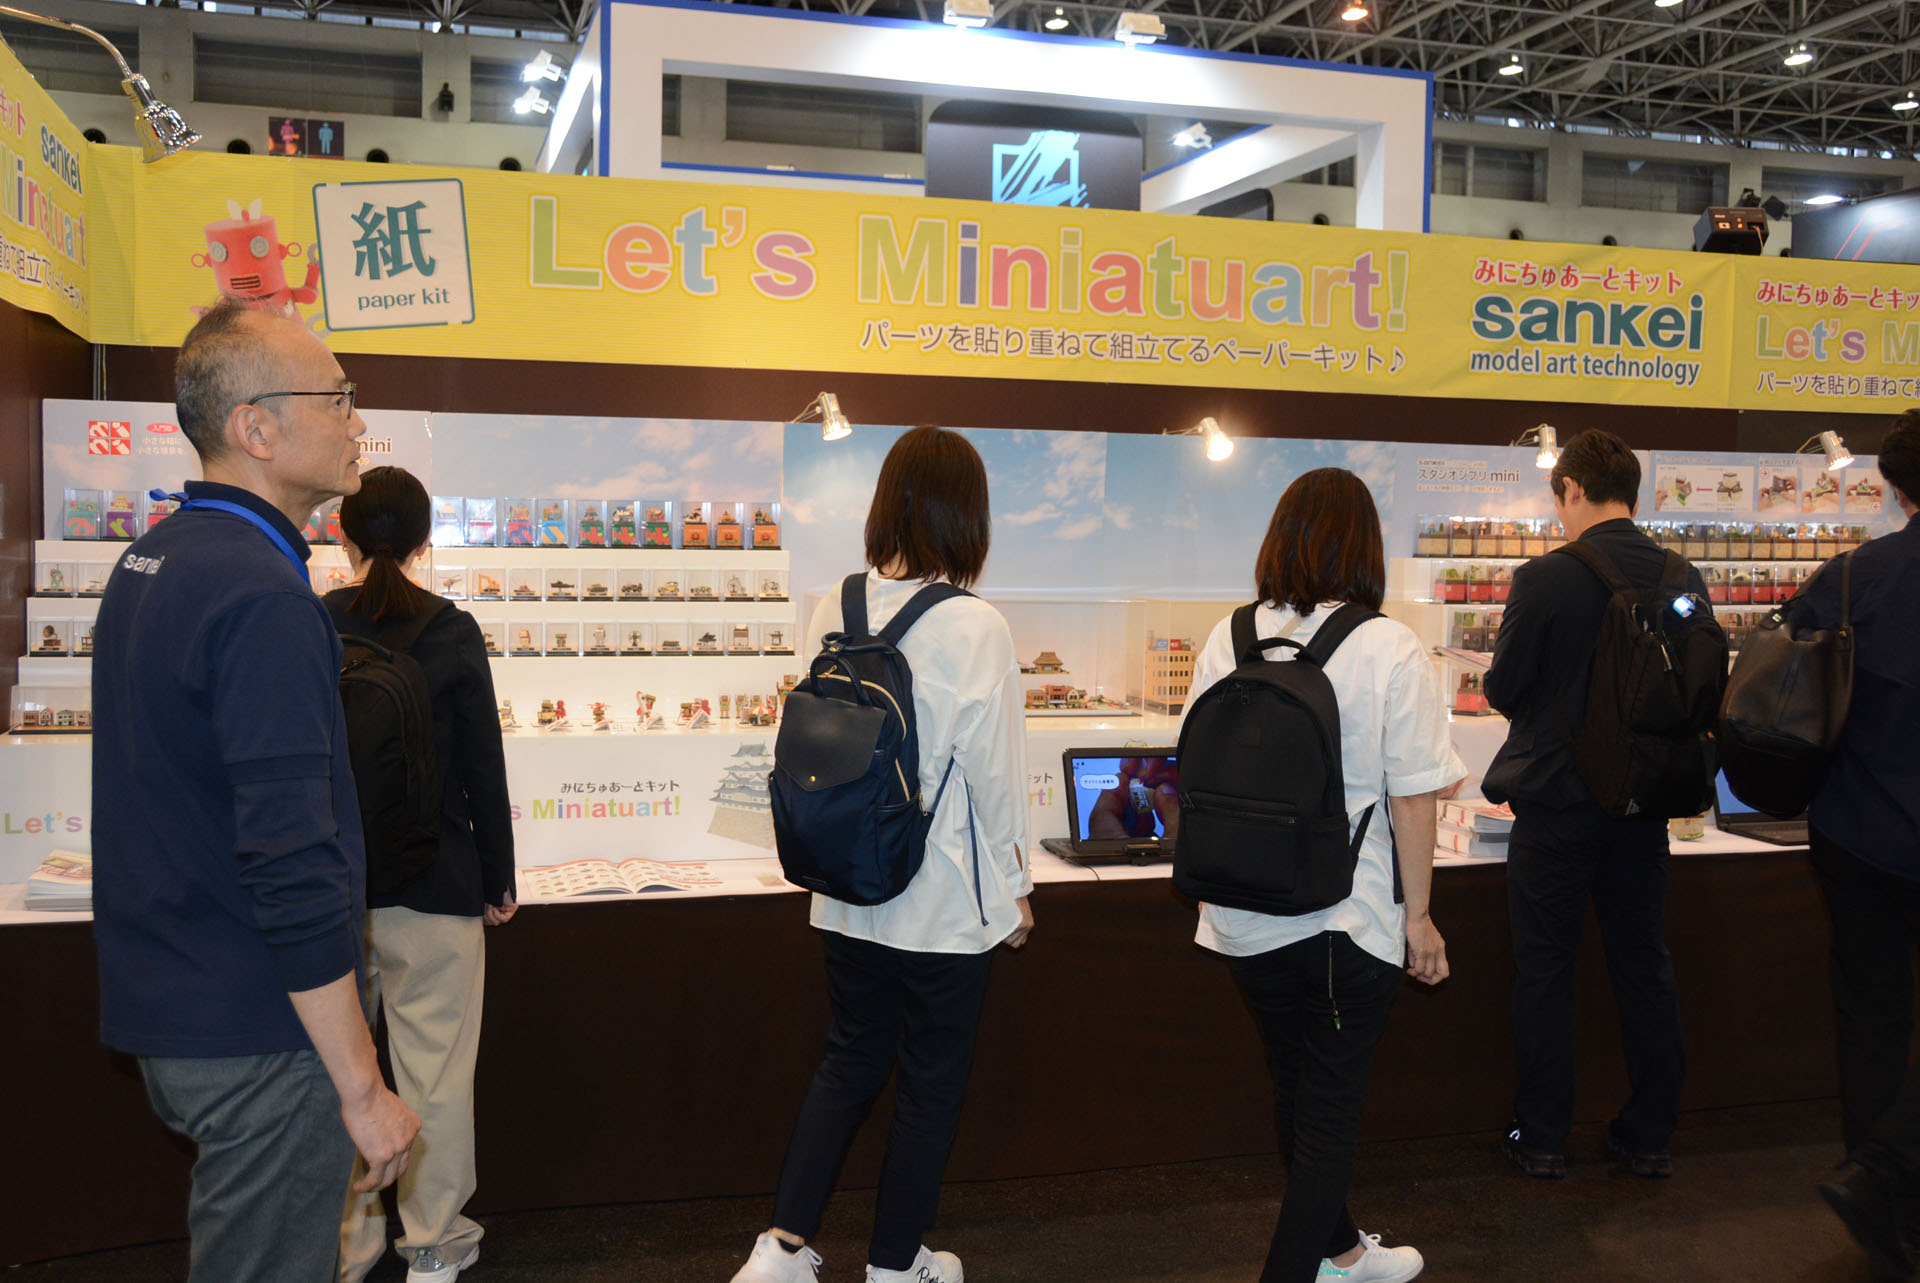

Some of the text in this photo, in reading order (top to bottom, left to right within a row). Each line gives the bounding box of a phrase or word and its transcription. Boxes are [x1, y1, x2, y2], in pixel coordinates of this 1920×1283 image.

[41, 125, 82, 194] sankei
[351, 200, 437, 281] 紙
[531, 197, 1410, 331] Let's Miniatuart!
[1473, 259, 1683, 294] みにちゅあーとキット
[358, 288, 451, 311] paper kit
[1472, 294, 1704, 350] sankei
[1757, 316, 1866, 362] Let's
[1471, 350, 1700, 386] model art technology
[1418, 468, 1520, 482] スタジオジブリ mini
[560, 780, 680, 794] みにちゅあーとキット
[5, 811, 83, 834] Let's
[533, 795, 681, 820] Miniatuart!
